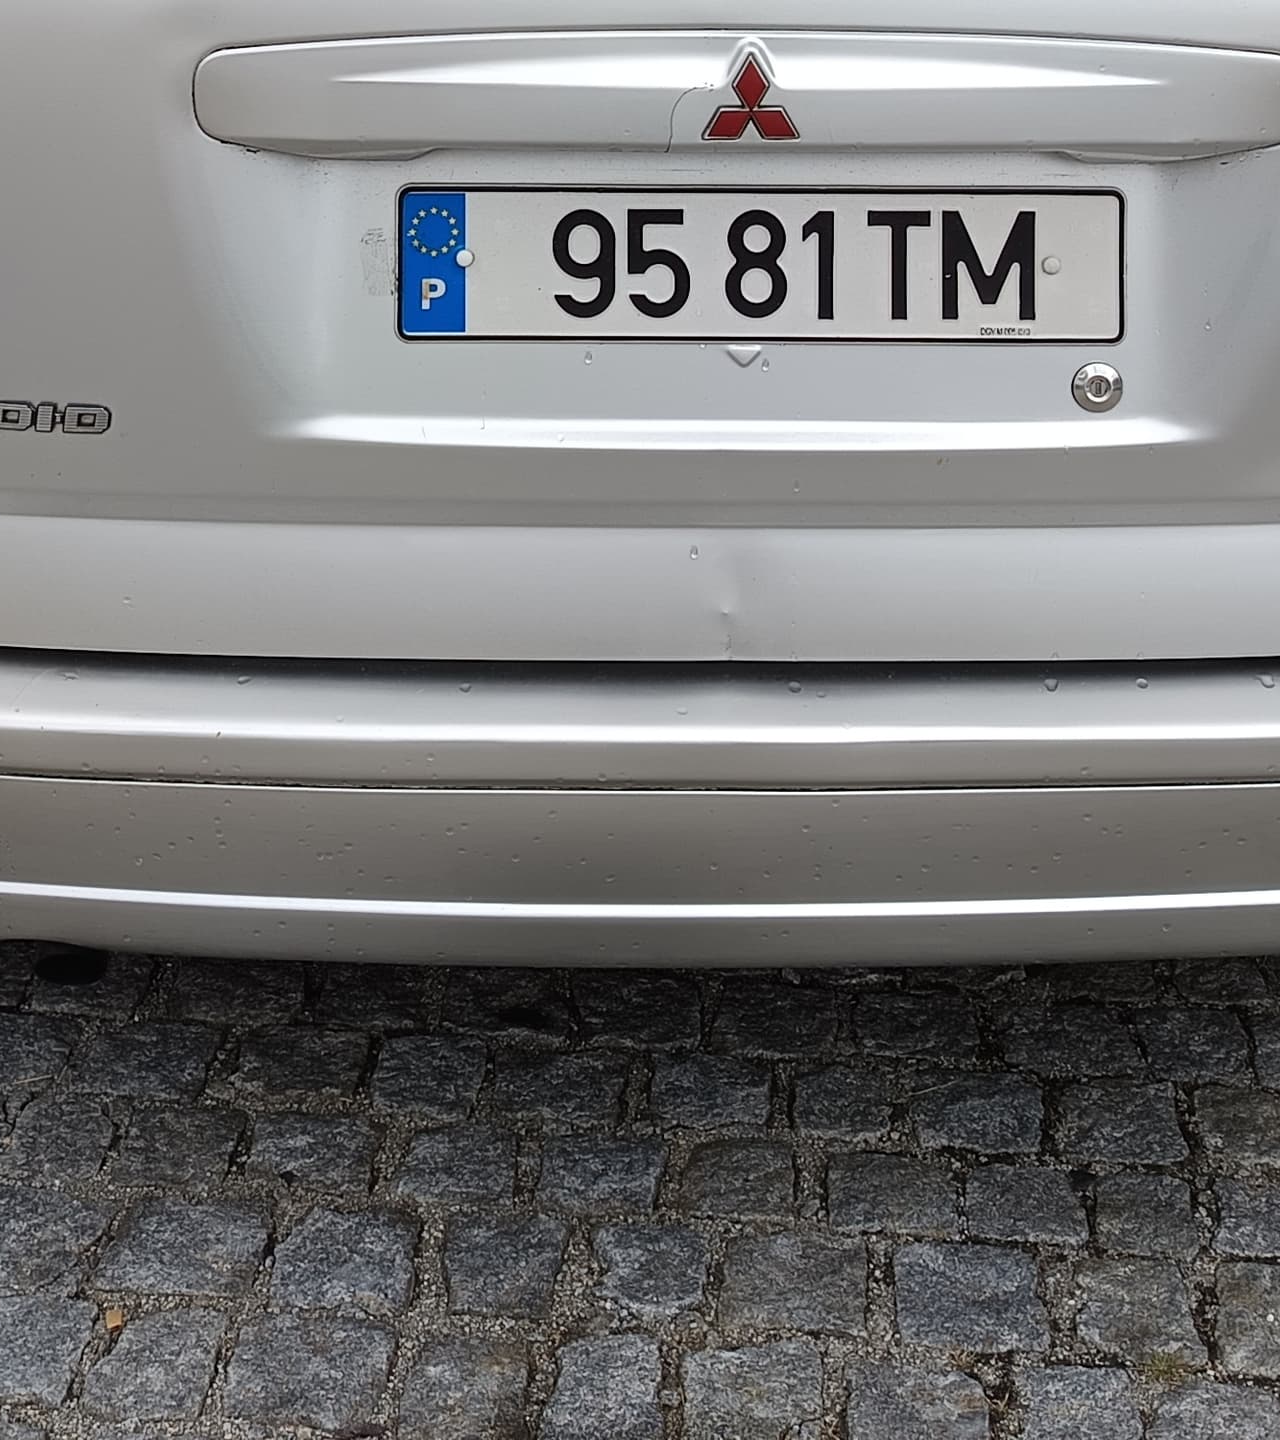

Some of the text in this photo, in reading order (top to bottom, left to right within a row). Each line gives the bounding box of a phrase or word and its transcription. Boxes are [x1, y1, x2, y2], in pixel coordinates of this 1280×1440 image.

[421, 278, 447, 310] P
[552, 208, 1037, 321] 95 81 TM
